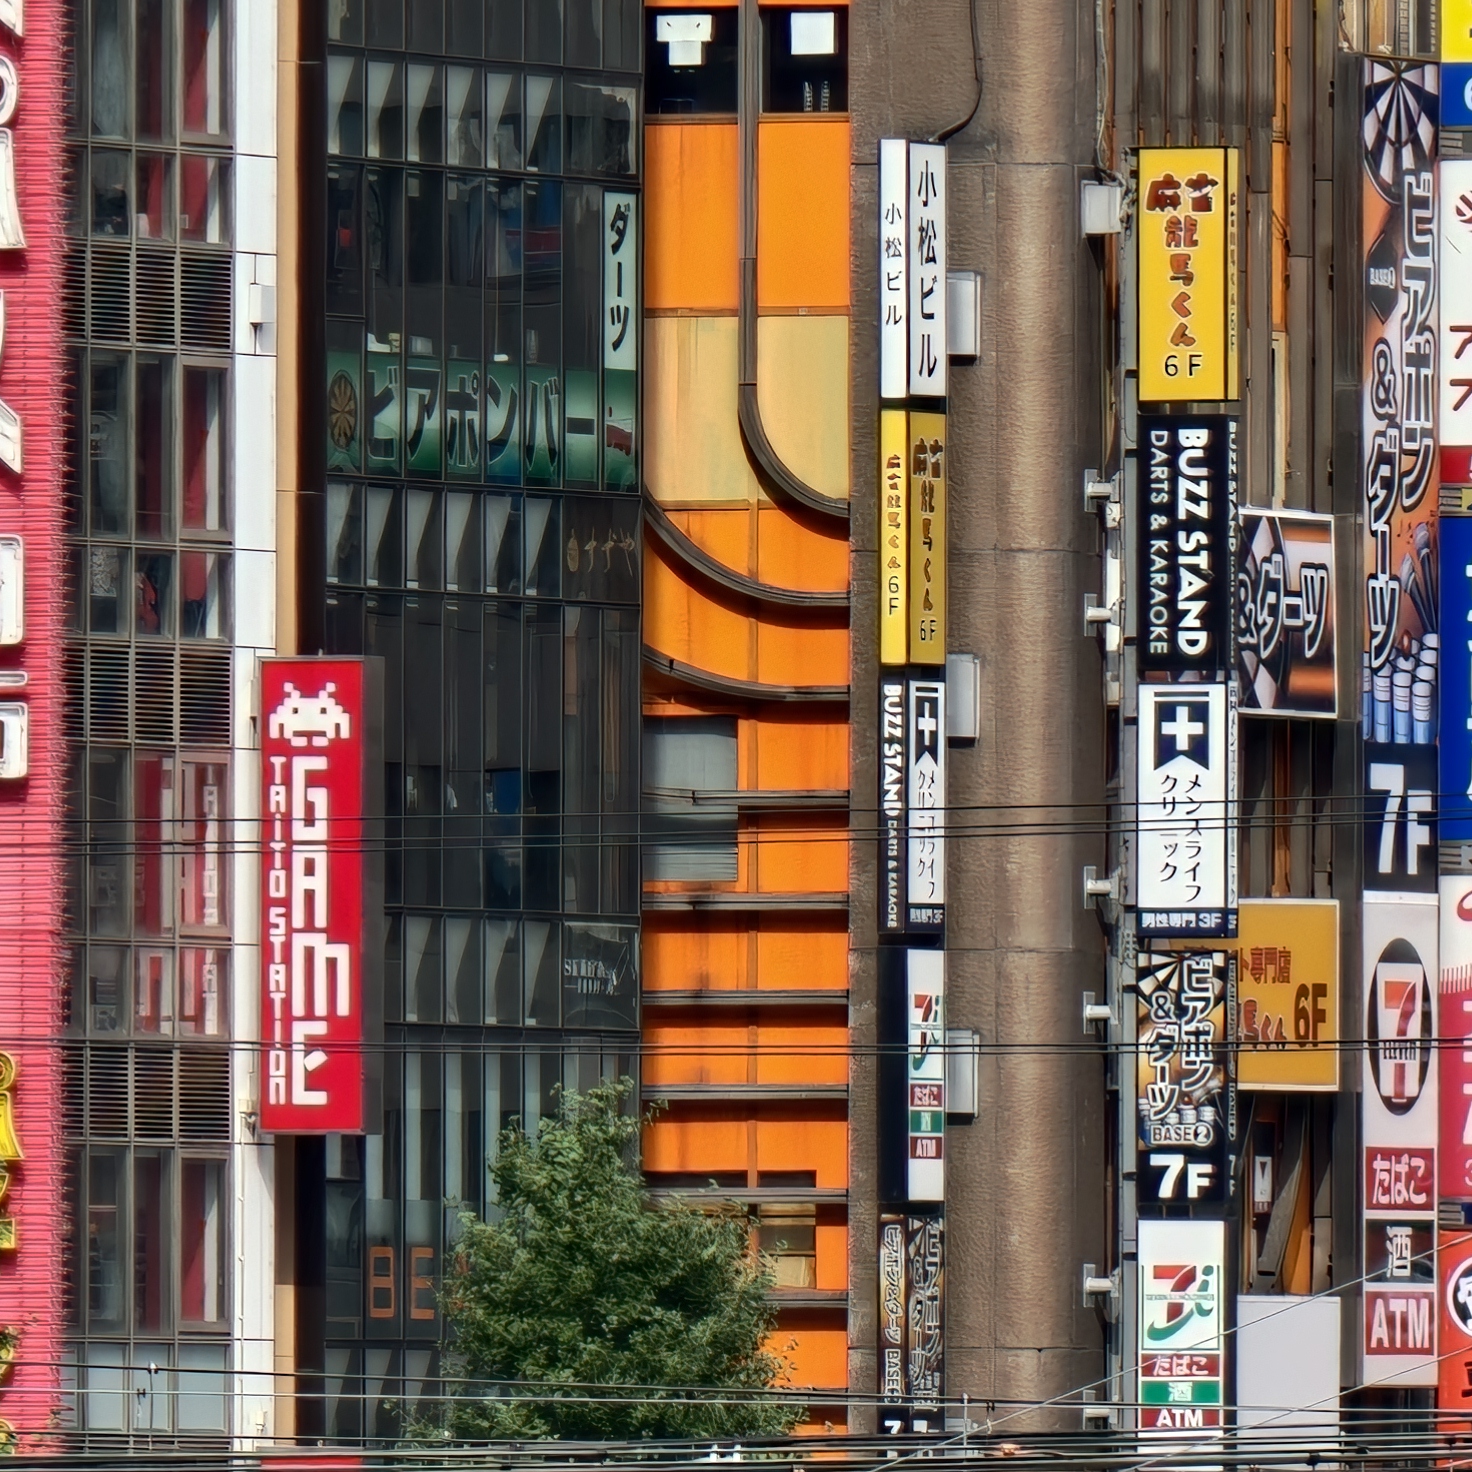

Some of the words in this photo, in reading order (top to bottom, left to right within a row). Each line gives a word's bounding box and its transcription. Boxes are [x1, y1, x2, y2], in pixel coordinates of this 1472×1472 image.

[610, 202, 631, 353] ダーツ
[885, 203, 903, 326] 小松ビル
[918, 160, 938, 379] 小松ビル
[1164, 354, 1204, 377] 6F
[367, 367, 596, 473] ビアポンバー
[1150, 430, 1168, 504] DARTS
[1178, 428, 1209, 519] BUZZ
[1150, 514, 1168, 531] &
[1150, 539, 1168, 654] KARAOKE
[1178, 530, 1209, 655] STAND
[1238, 553, 1328, 659] &ダーツ
[919, 620, 937, 641] 6F
[883, 684, 903, 738] BUZZ
[883, 742, 903, 817] STAND
[268, 756, 287, 895] TAITO
[1369, 763, 1433, 875] 7F
[290, 756, 350, 1105] GAME
[1199, 913, 1221, 927] 3F
[268, 932, 287, 1105] STATION
[1181, 958, 1214, 1092] ビアポン
[1294, 983, 1327, 1048] 6F
[1147, 991, 1179, 1120] &ダーツ
[915, 1139, 936, 1157] ATM
[1149, 1154, 1213, 1199] 7F
[1372, 1153, 1427, 1205] たばこ
[1386, 1225, 1413, 1278] 酒
[1370, 1298, 1430, 1348] ATM
[1153, 1355, 1209, 1377] たばこ
[1168, 1382, 1193, 1402] 酒
[1156, 1409, 1203, 1427] ATM
